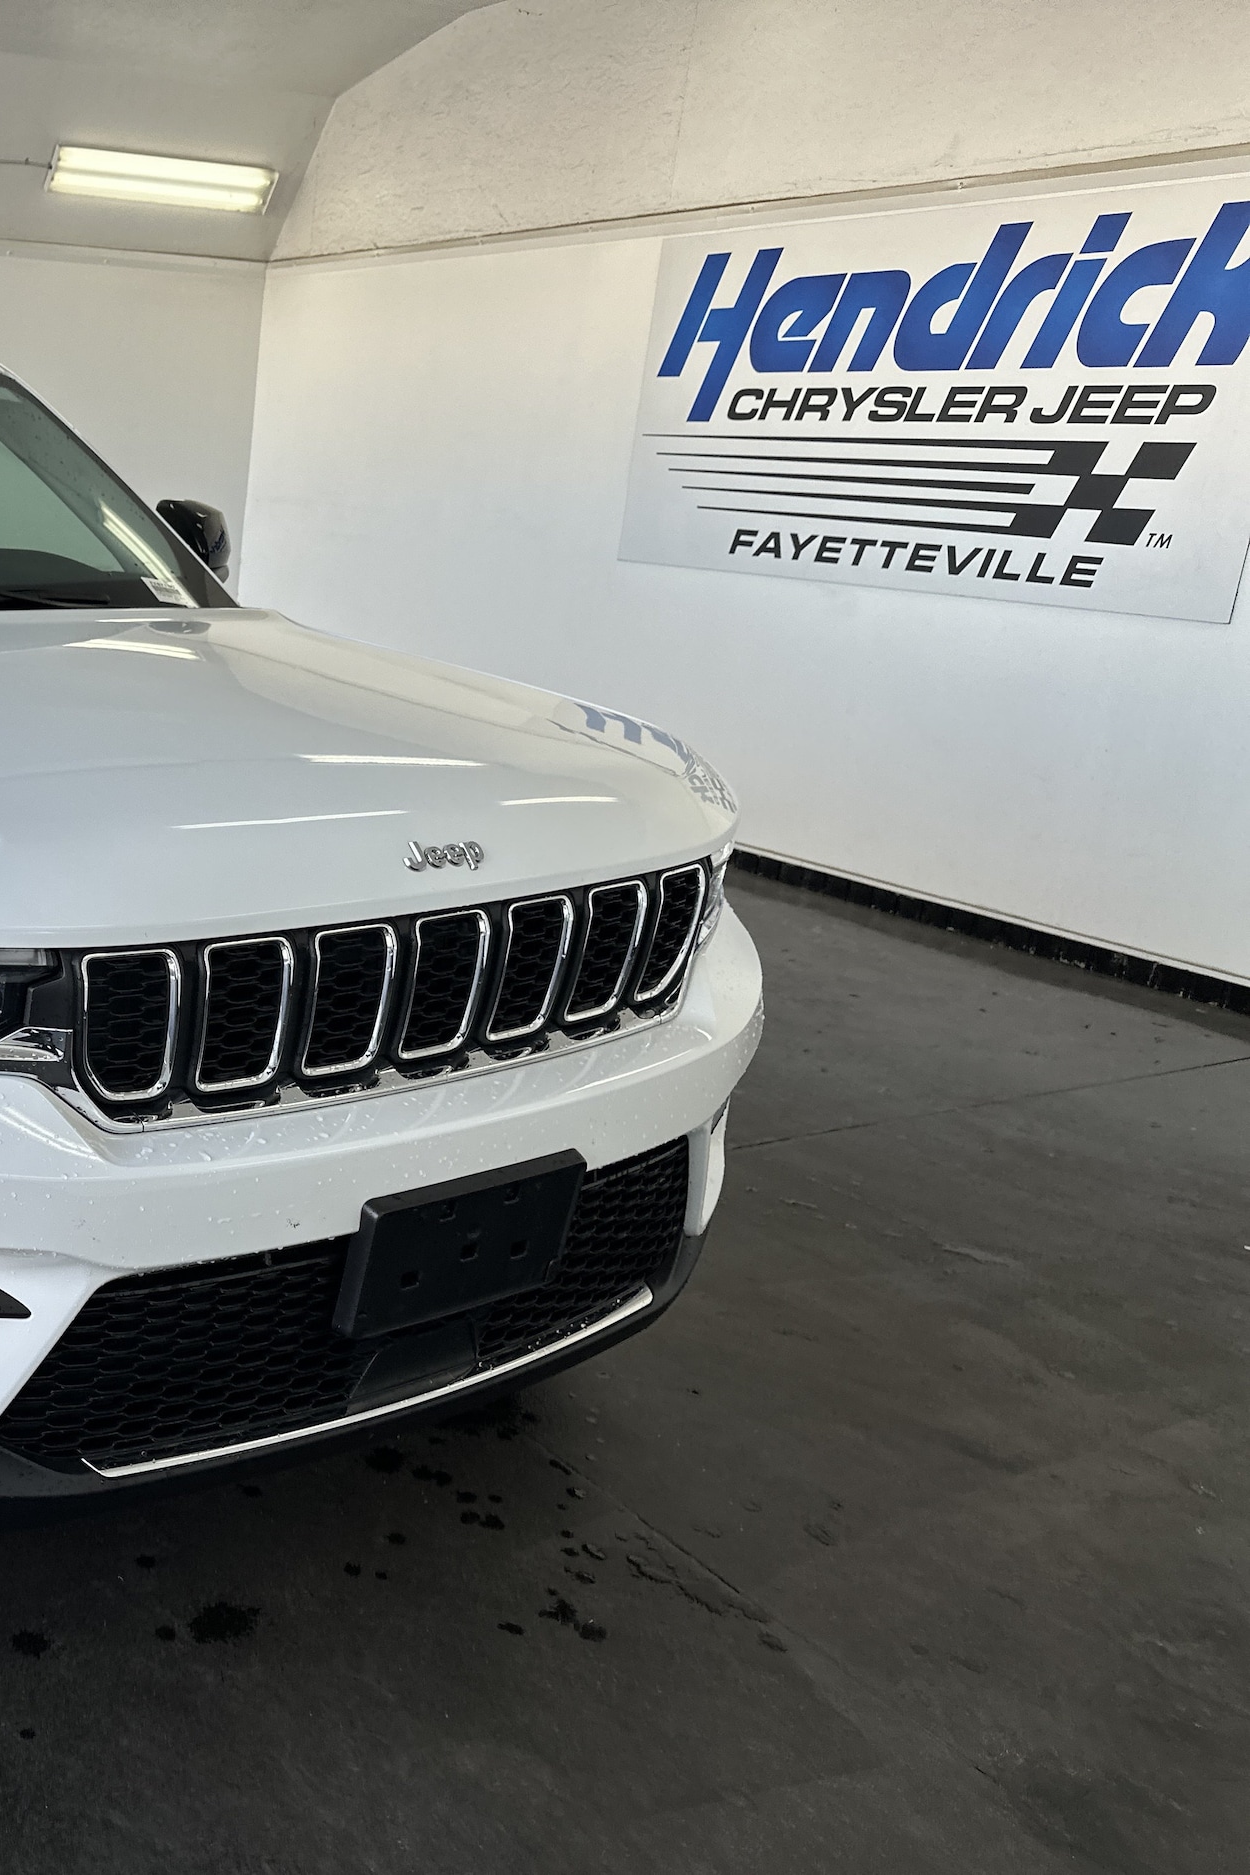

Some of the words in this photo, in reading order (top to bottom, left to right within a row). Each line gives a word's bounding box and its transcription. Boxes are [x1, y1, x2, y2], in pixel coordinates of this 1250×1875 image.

[656, 200, 1250, 422] Hendrick
[726, 385, 1030, 423] CHRYSLER
[1029, 384, 1217, 425] JEEP
[728, 529, 1105, 589] FAYETTEVILLE
[1145, 533, 1173, 549] TM
[402, 840, 485, 872] Jeep
